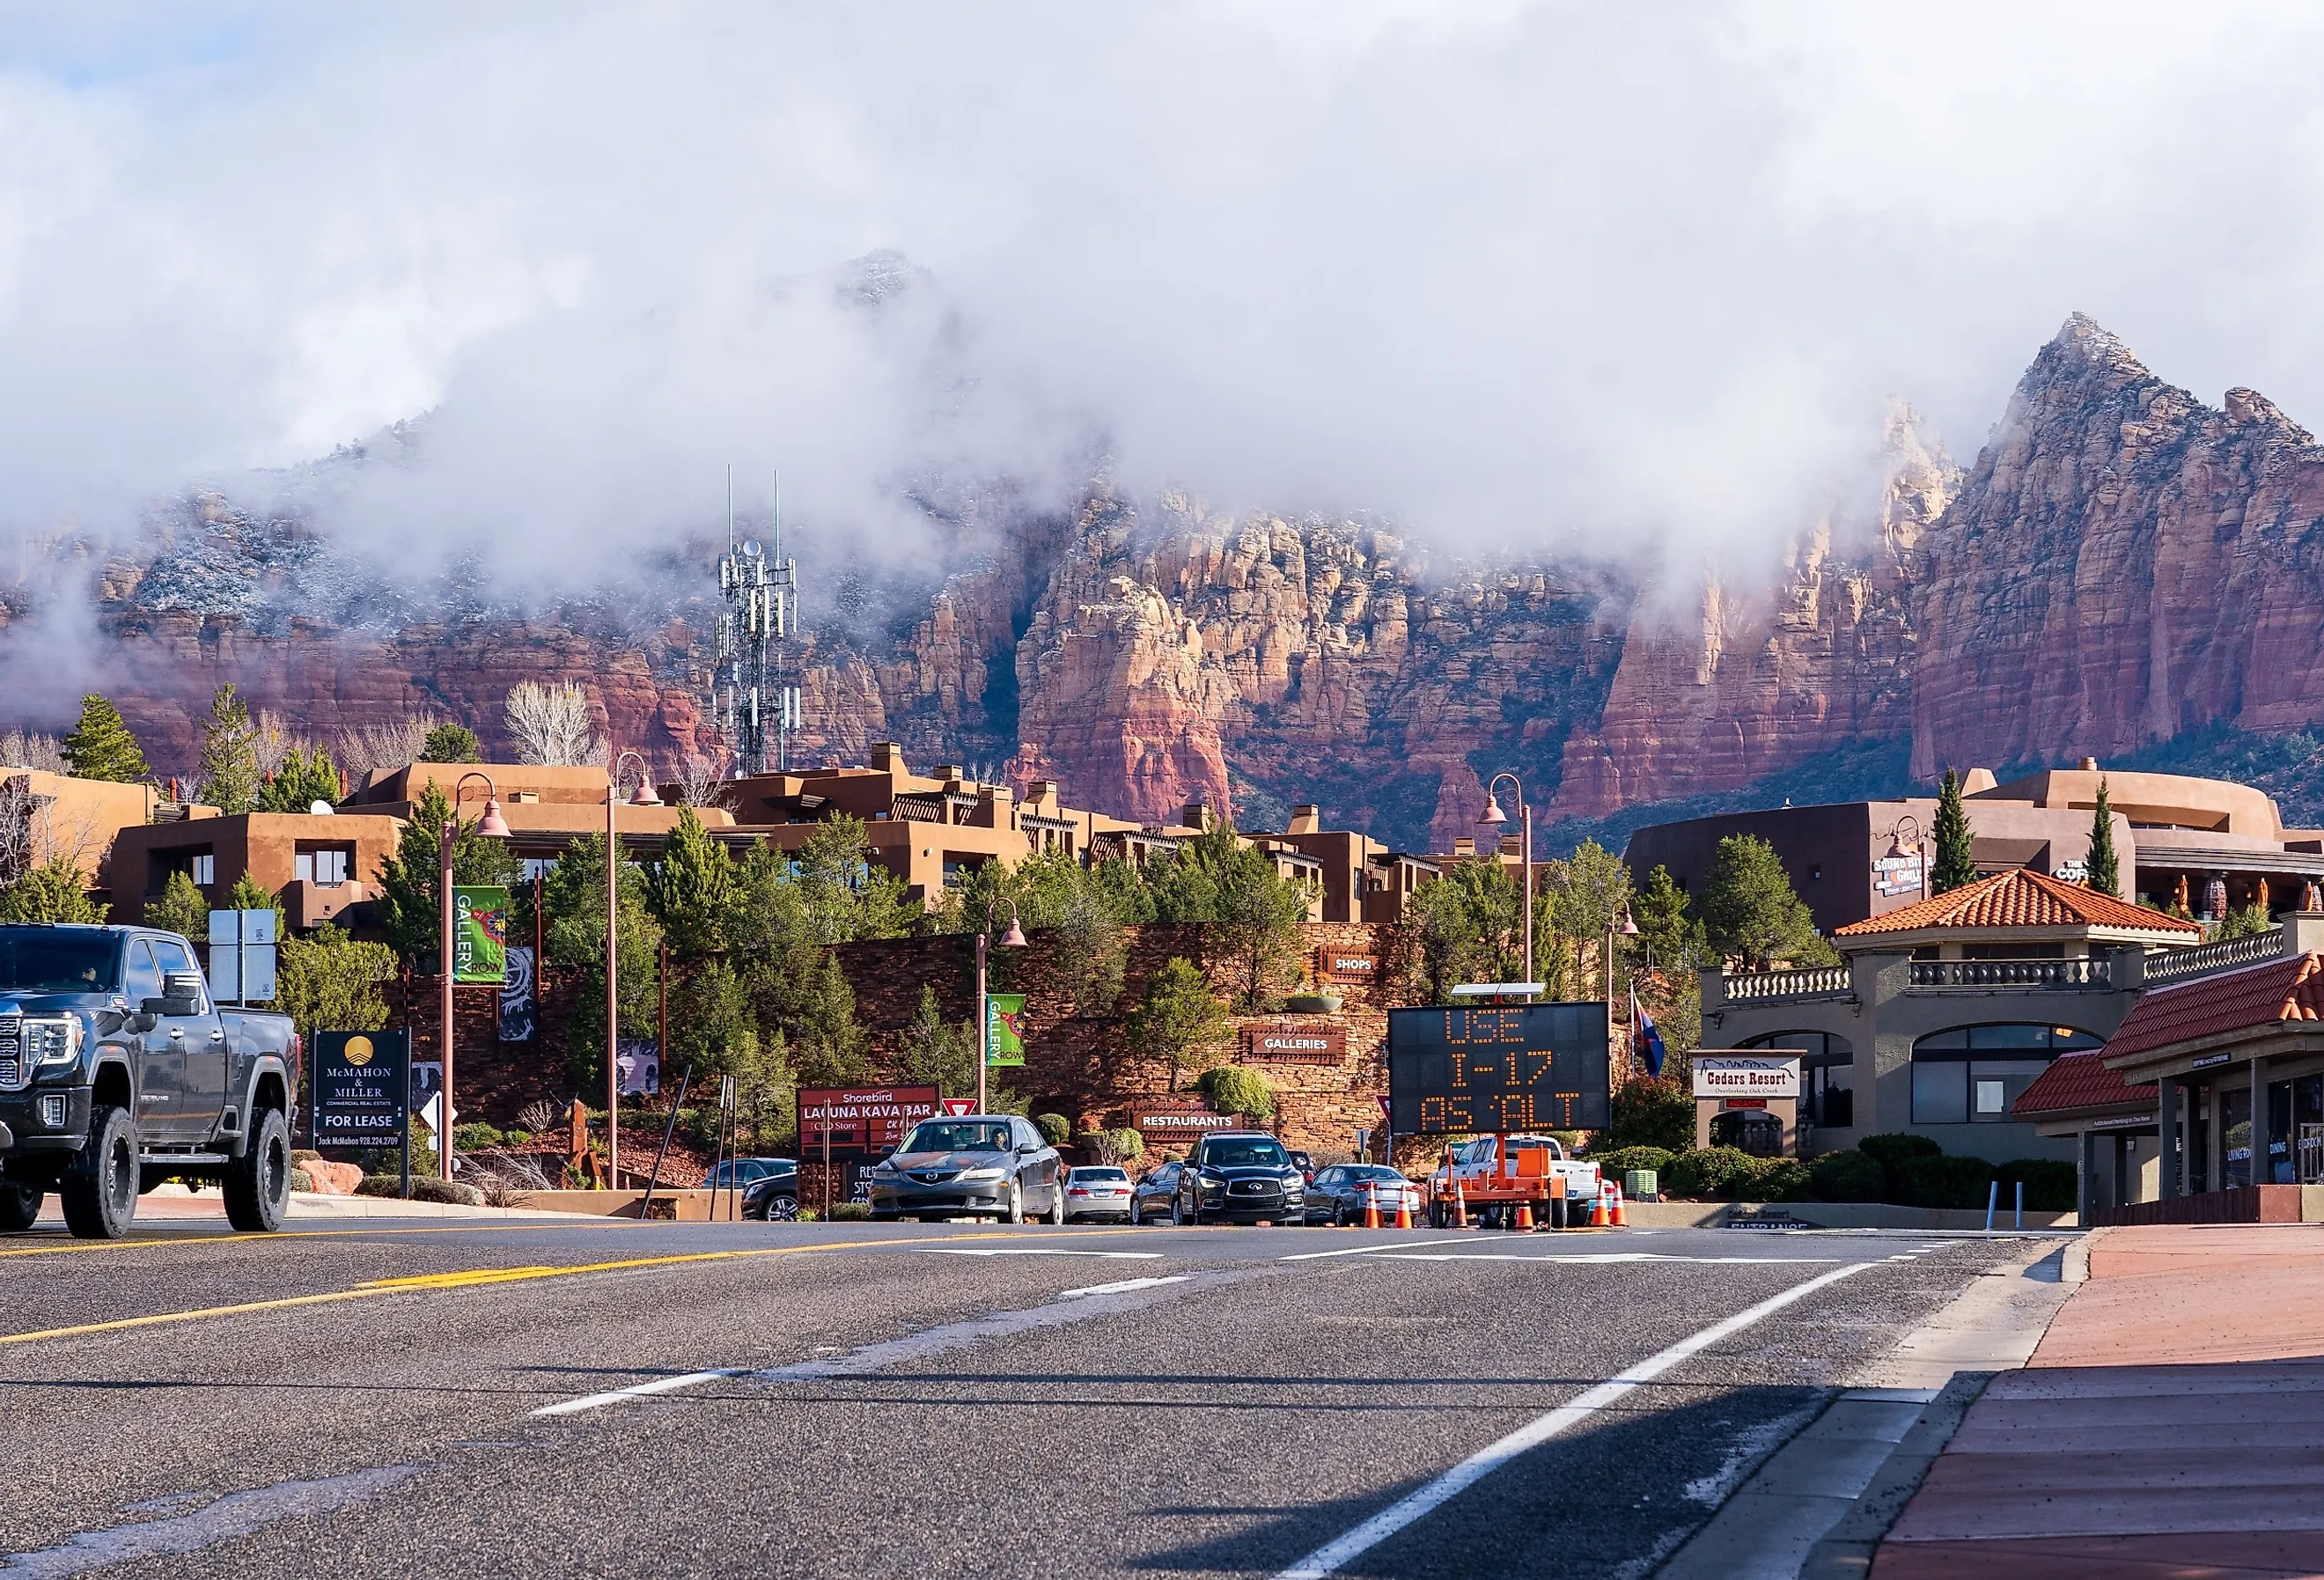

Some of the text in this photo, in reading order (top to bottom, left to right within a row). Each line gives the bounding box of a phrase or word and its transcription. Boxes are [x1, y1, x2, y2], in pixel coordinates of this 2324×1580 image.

[1873, 856, 1934, 871] SOUND BITS
[457, 894, 473, 974] GALLERY
[472, 962, 502, 973] ROW
[1335, 959, 1372, 969] SHOPS
[989, 1001, 1001, 1060] GALLERY
[1445, 1009, 1525, 1045] USE
[1264, 1039, 1327, 1049] GALLERIES
[1000, 1051, 1022, 1060] ROW
[327, 1068, 392, 1077] McMAHON
[1451, 1051, 1553, 1088] I-17
[355, 1078, 364, 1087] &
[1708, 1072, 1786, 1085] Cedars Resort
[335, 1088, 383, 1098] MILLER
[842, 1091, 893, 1103] Shorebird
[862, 1106, 901, 1118] KAVA
[1421, 1097, 1474, 1131] AS
[325, 1116, 393, 1127] FOR LEASE
[835, 1121, 857, 1130] Store
[887, 1120, 898, 1128] CK
[1143, 1116, 1232, 1127] RESTAURANTS
[318, 1136, 399, 1145] Jack McMahon 928.224.2709
[2269, 1142, 2286, 1154] DINING
[2227, 1148, 2243, 1161] LIVING
